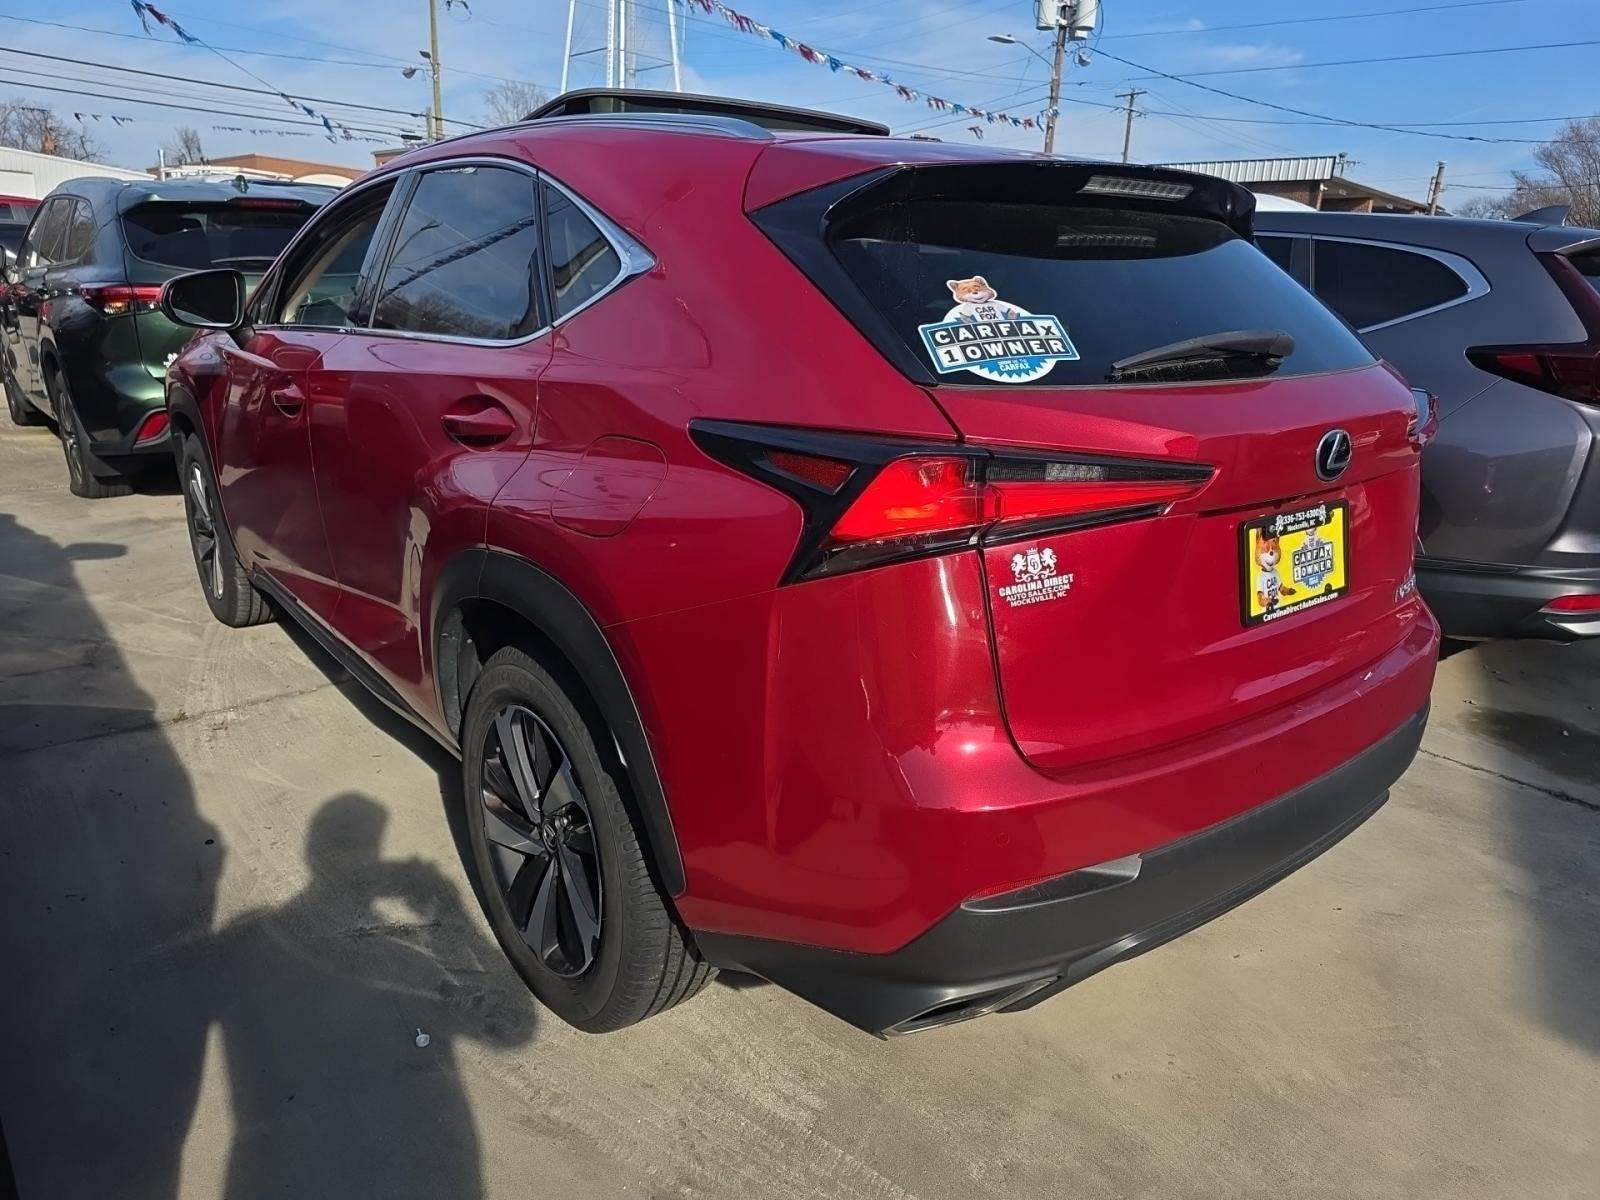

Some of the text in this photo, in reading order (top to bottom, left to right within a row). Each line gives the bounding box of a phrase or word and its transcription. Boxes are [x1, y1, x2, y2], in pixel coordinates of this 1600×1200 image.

[975, 306, 996, 314] CAR
[980, 312, 999, 321] FOX
[934, 322, 1057, 345] CARFAX
[943, 340, 1066, 363] 1 OWNER
[999, 363, 1031, 371] CARFAX
[1294, 544, 1332, 565] CARFAX
[1301, 560, 1332, 576] OWNER
[999, 573, 1074, 597] CAROLINA DIRECT
[1006, 584, 1071, 602] AUTO SALES.COM
[1057, 590, 1068, 599] NC
[1263, 592, 1339, 622] CarolinaDirectAutoSales.com
